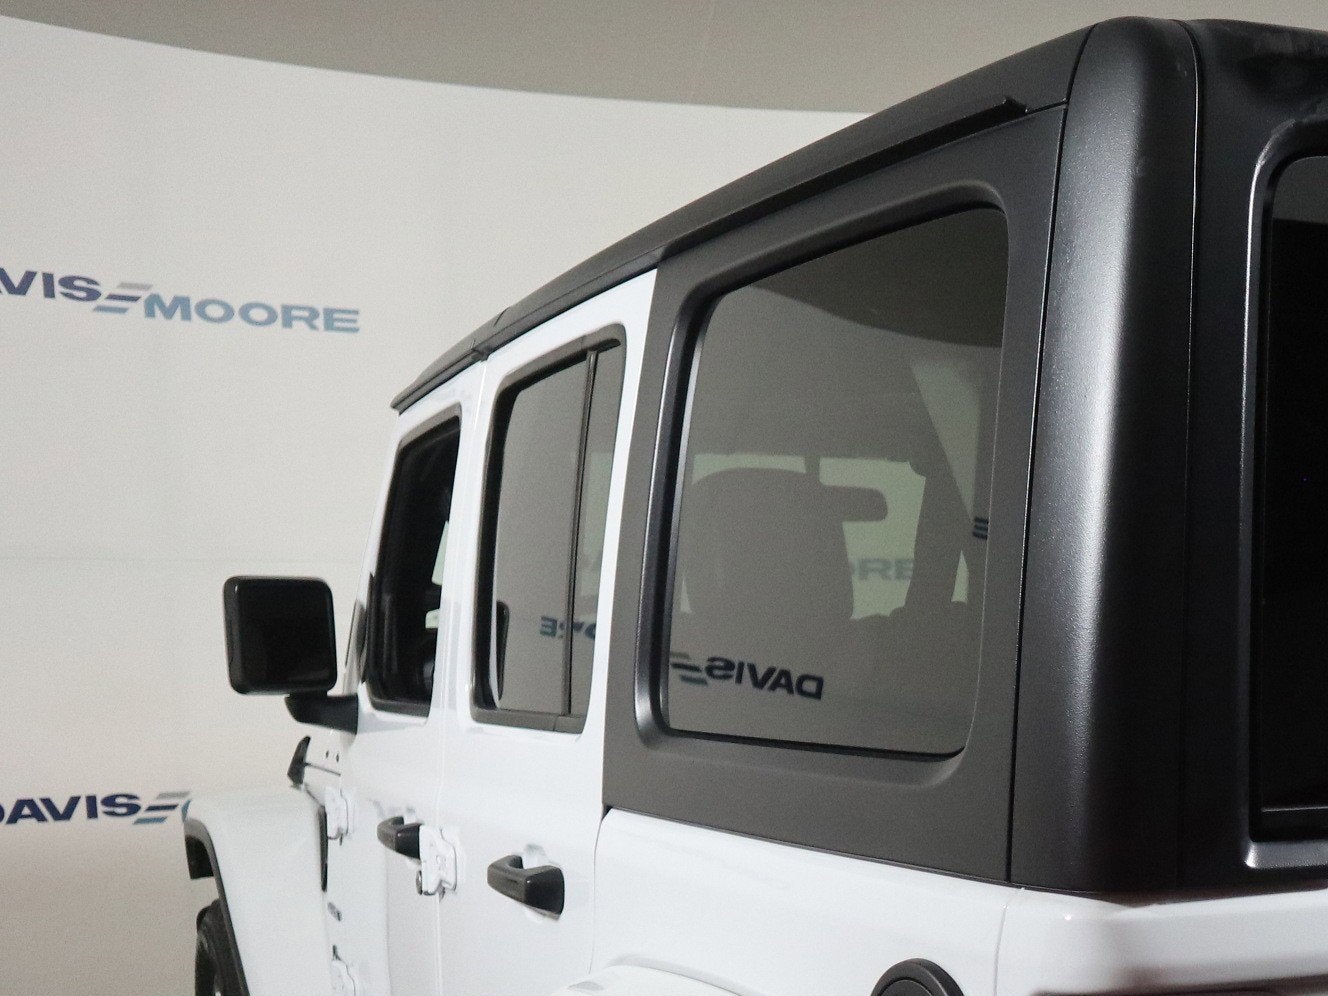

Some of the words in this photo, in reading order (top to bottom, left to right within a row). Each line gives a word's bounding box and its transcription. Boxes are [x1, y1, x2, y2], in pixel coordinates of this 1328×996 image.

[0, 267, 102, 302] VIS
[143, 293, 360, 333] MOORE
[0, 792, 142, 825] AVIS
